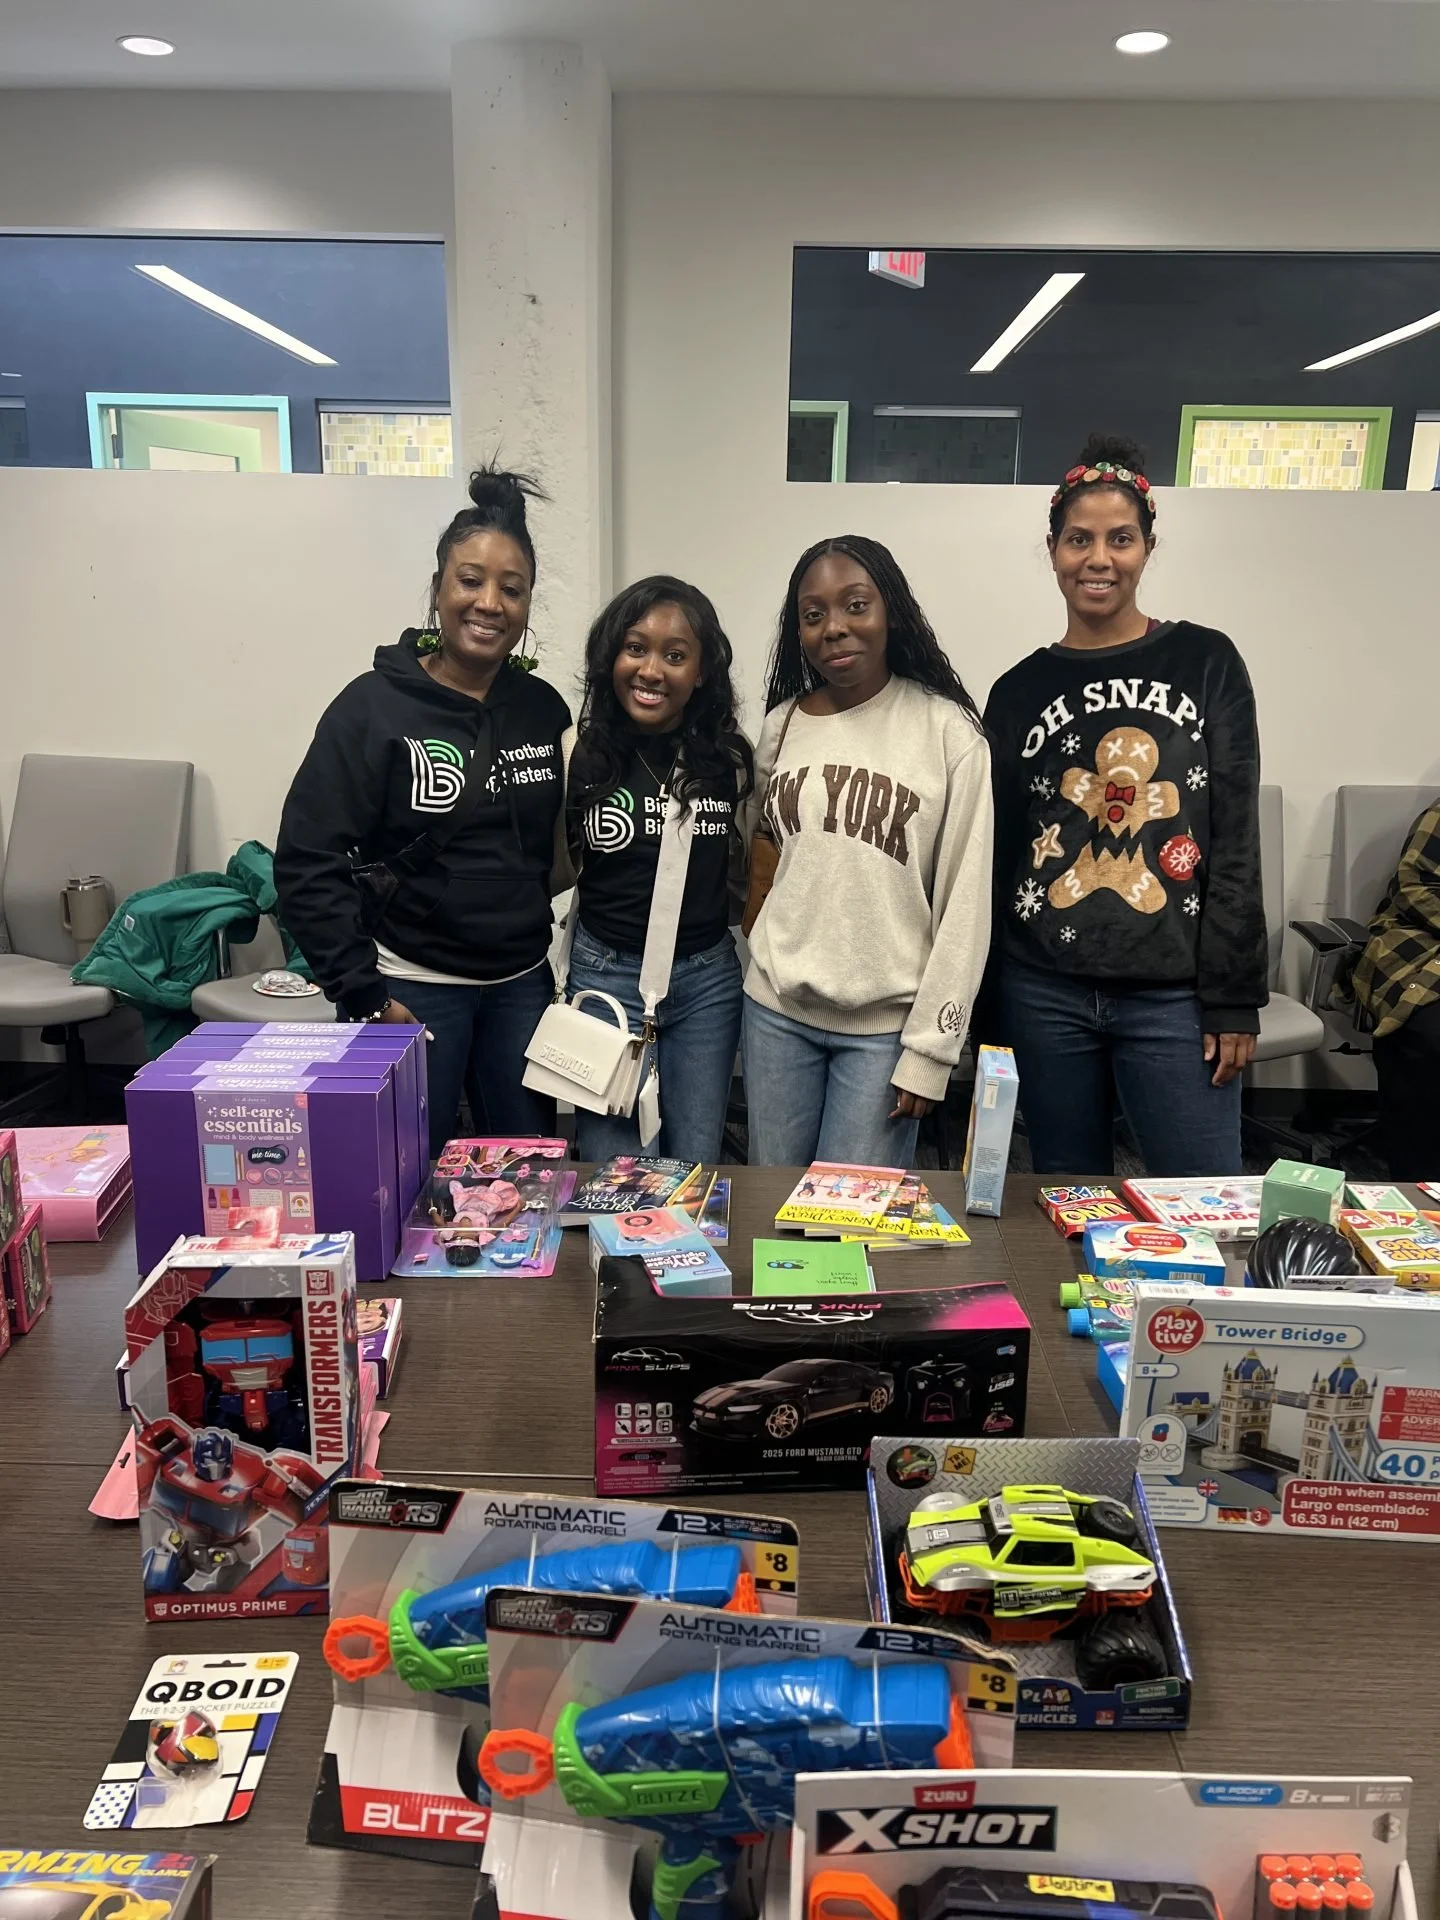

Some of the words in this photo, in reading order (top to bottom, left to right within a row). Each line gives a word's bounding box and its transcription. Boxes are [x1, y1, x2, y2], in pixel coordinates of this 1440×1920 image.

[1022, 696, 1074, 759] OH
[696, 797, 731, 813] others
[822, 764, 921, 867] YORK
[645, 818, 661, 835] Bi
[692, 819, 728, 835] sters.
[220, 1105, 283, 1118] self-care
[204, 1118, 302, 1133] essentials
[568, 1199, 636, 1213] Nancy
[1060, 1200, 1128, 1223] UNO
[1169, 1210, 1259, 1225] ograph
[1133, 1232, 1176, 1241] CONSOLE
[732, 1303, 813, 1311] SLIPS
[819, 1302, 884, 1310] PINK
[1155, 1315, 1198, 1332] Play
[1155, 1329, 1194, 1344] tive
[1215, 1325, 1277, 1340] Tower
[1281, 1327, 1347, 1344] Bridge
[645, 1363, 691, 1371] SLIPS
[308, 1299, 344, 1465] TRANSFORMERS
[988, 1378, 1015, 1393] USB
[1406, 1387, 1440, 1398] WARN
[1401, 1415, 1440, 1425] ADVER
[762, 1448, 783, 1458] 2025
[785, 1448, 806, 1457] FORD
[807, 1447, 845, 1456] MUSTANG
[948, 1450, 966, 1465] TRY
[953, 1456, 971, 1471] ME!
[1380, 1453, 1426, 1478] 40
[1292, 1483, 1342, 1497] Length
[1345, 1487, 1385, 1498] when
[1388, 1490, 1440, 1501] assem
[341, 1503, 440, 1523] WARRIORS
[484, 1502, 627, 1526] AUTOMATIC
[1290, 1498, 1333, 1511] Largo
[1336, 1502, 1430, 1516] ensemblado:
[484, 1517, 557, 1531] ROTATING
[1290, 1513, 1328, 1525] 16.53
[1331, 1515, 1343, 1526] in
[1348, 1516, 1368, 1529] (42
[1372, 1518, 1399, 1531] cm)
[171, 1602, 237, 1614] OPTIMUS
[242, 1600, 287, 1611] PRIME
[660, 1613, 820, 1642] AUTOMATIC
[659, 1628, 741, 1647] ROTATING
[145, 1677, 286, 1704] QBOID
[140, 1707, 160, 1715] THE
[189, 1702, 233, 1713] POCKET
[234, 1700, 278, 1711] PUZZLE
[922, 1790, 968, 1803] ZURU
[1206, 1786, 1226, 1795] AIR
[362, 1802, 487, 1837] BLITZ
